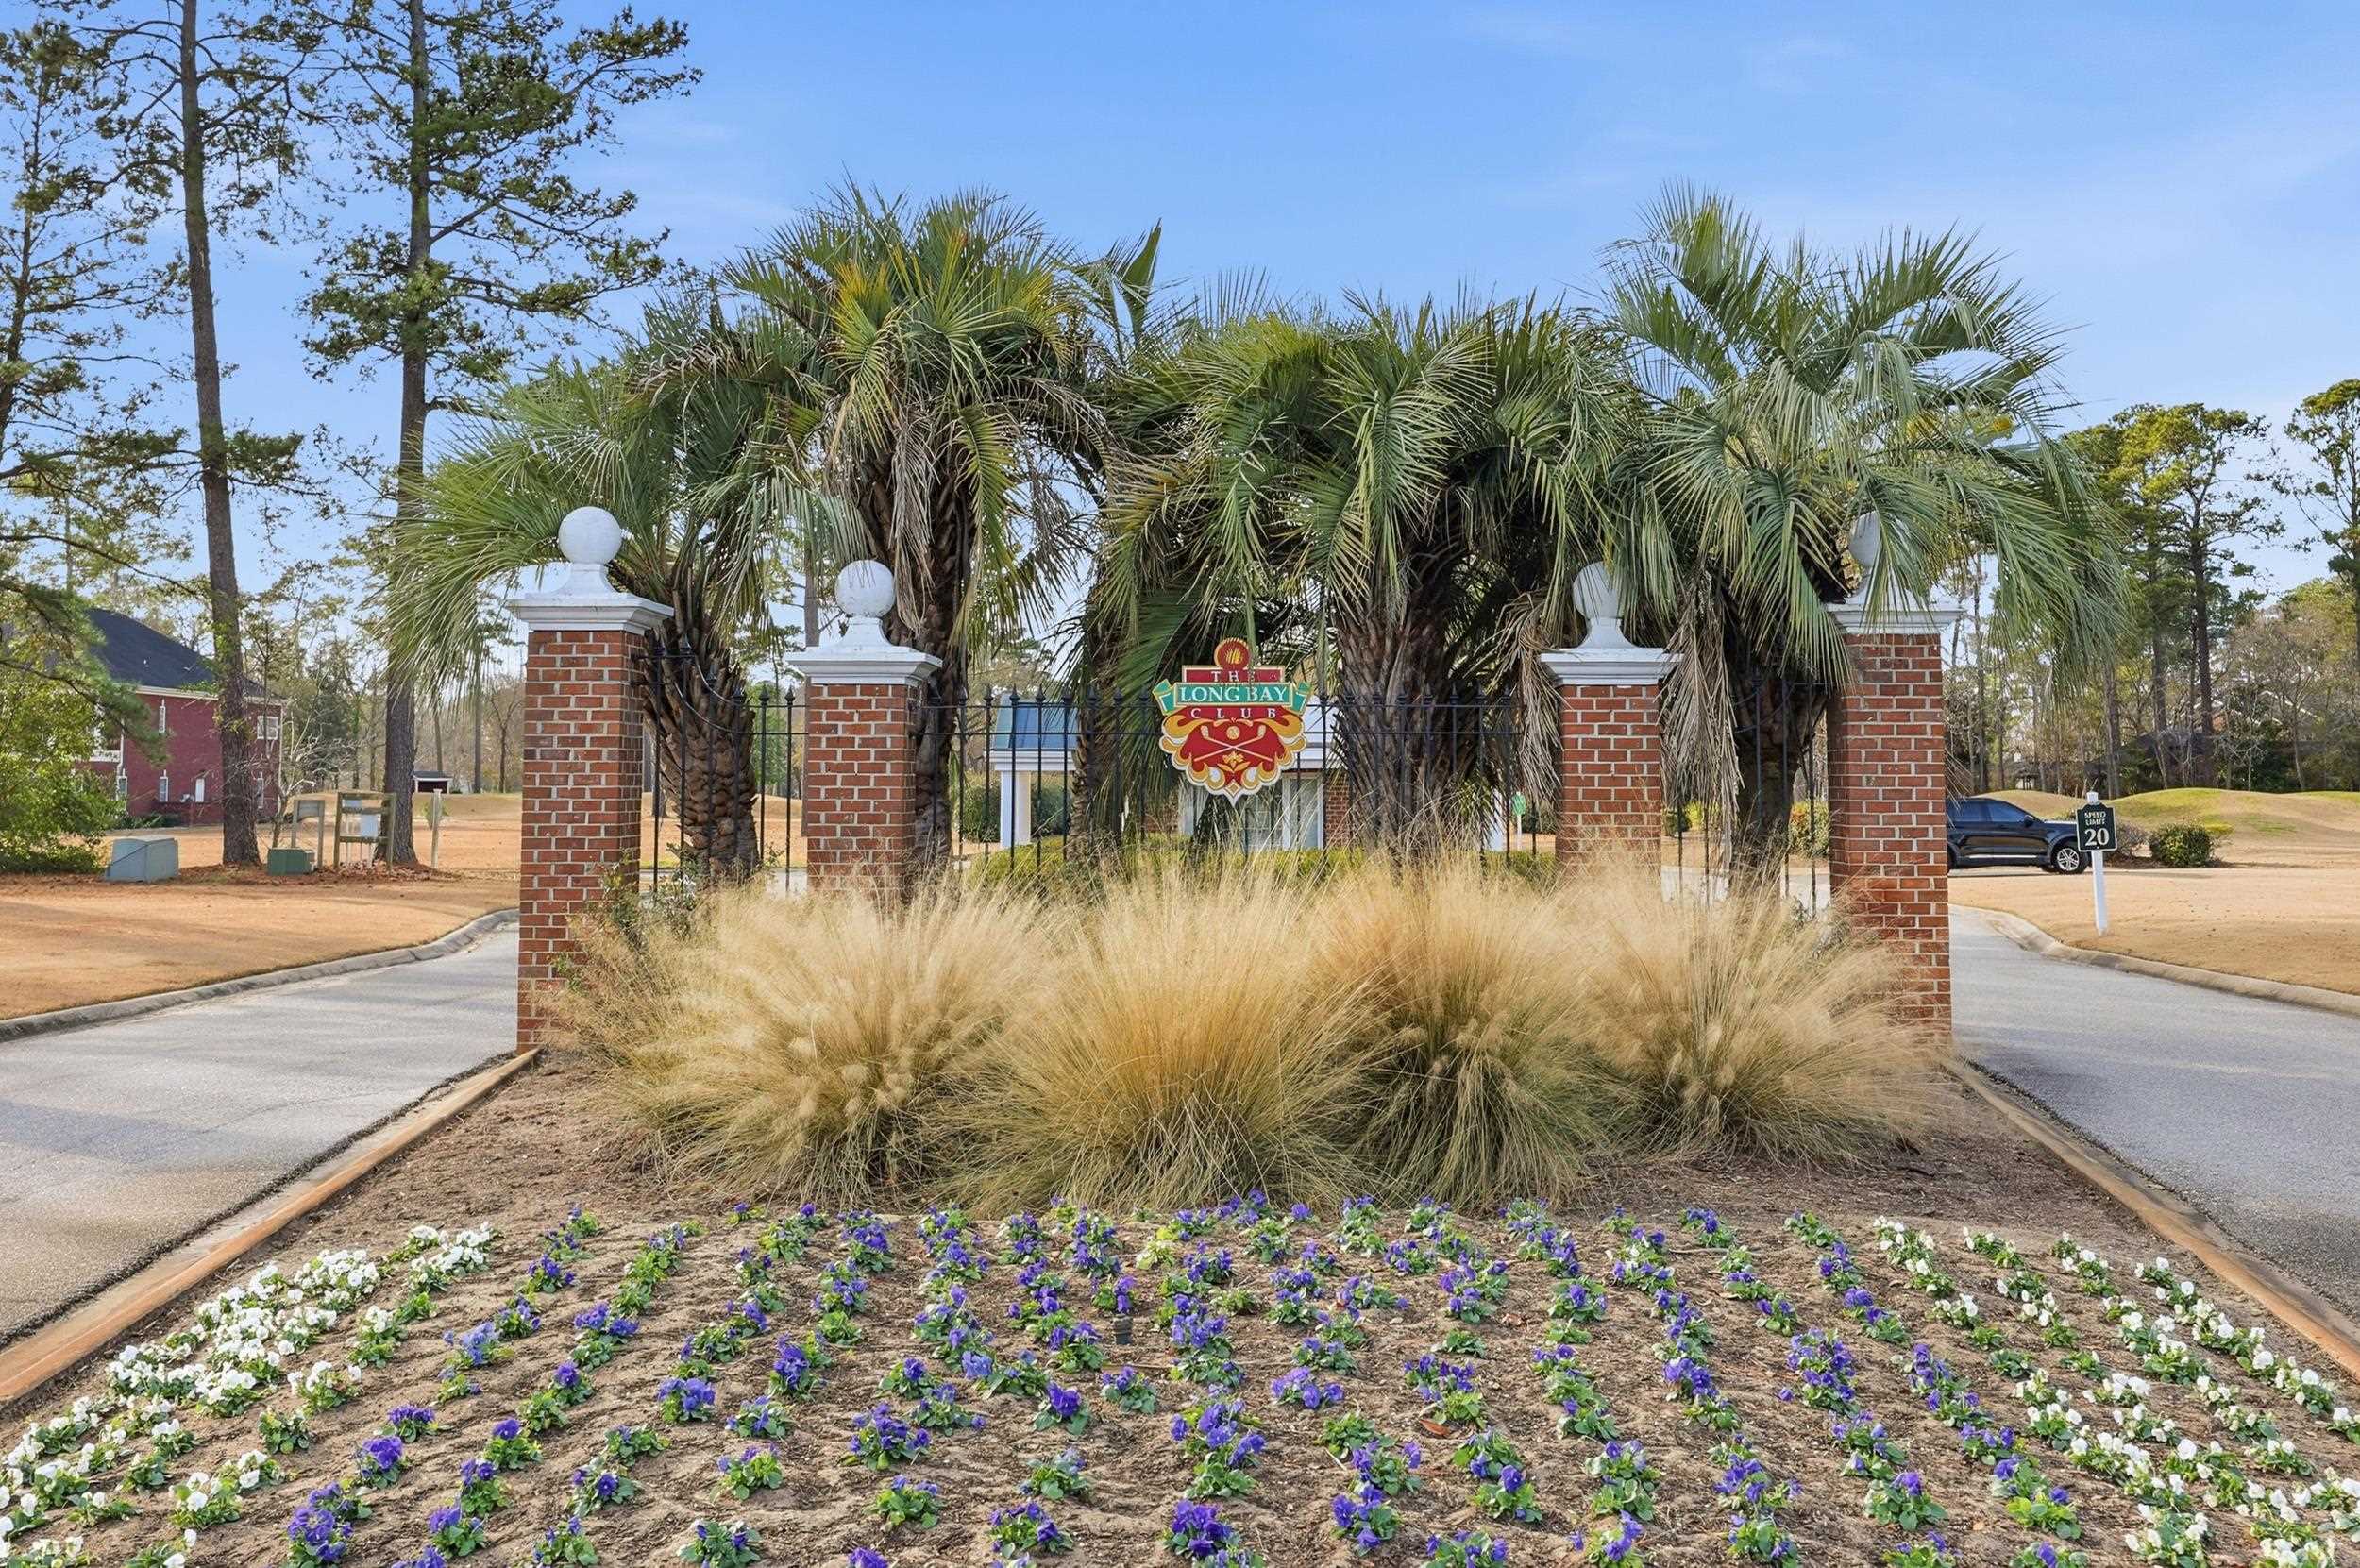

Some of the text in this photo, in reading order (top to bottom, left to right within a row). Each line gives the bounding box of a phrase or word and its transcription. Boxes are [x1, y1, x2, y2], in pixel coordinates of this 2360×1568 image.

[1211, 670, 1256, 683] THE
[1180, 686, 1288, 702] LONG BAY
[1190, 708, 1277, 719] CLUB
[2084, 827, 2110, 846] 20
